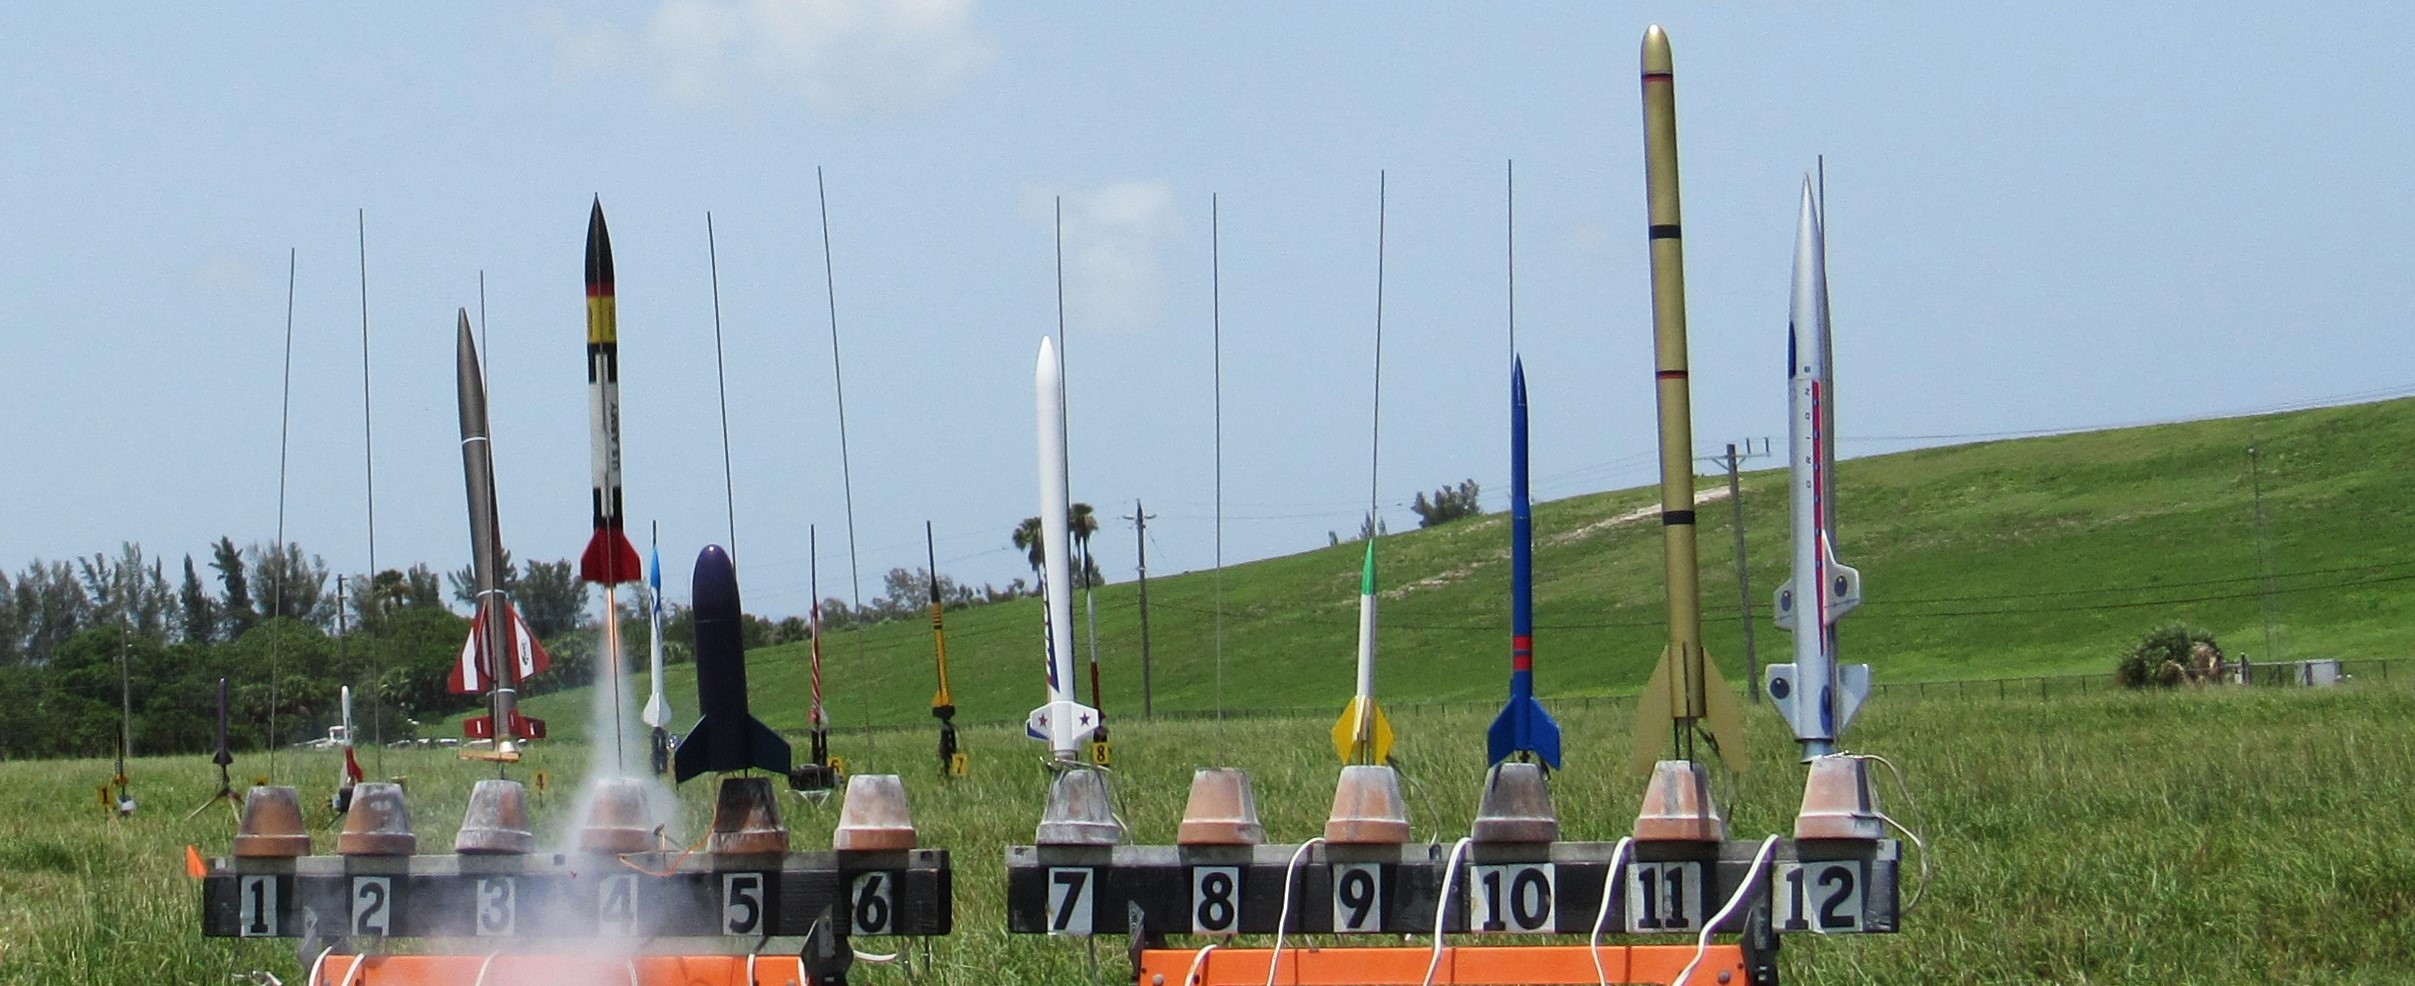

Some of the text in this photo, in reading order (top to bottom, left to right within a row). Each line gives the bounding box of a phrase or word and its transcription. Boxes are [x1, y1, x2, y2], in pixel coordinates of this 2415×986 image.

[1804, 387, 1812, 488] ORION
[955, 757, 964, 774] 7
[1097, 745, 1105, 761] 8
[251, 879, 269, 933] 1
[358, 882, 384, 935] 2
[481, 879, 510, 933] 3
[602, 877, 635, 930] 4
[728, 876, 760, 934] 5
[856, 875, 888, 933] 6
[1053, 871, 1088, 931] 7
[1197, 871, 1234, 931] 8
[1338, 868, 1375, 929] 9
[1482, 867, 1551, 931] 10
[1637, 865, 1690, 929] 11
[1785, 865, 1855, 929] 12
